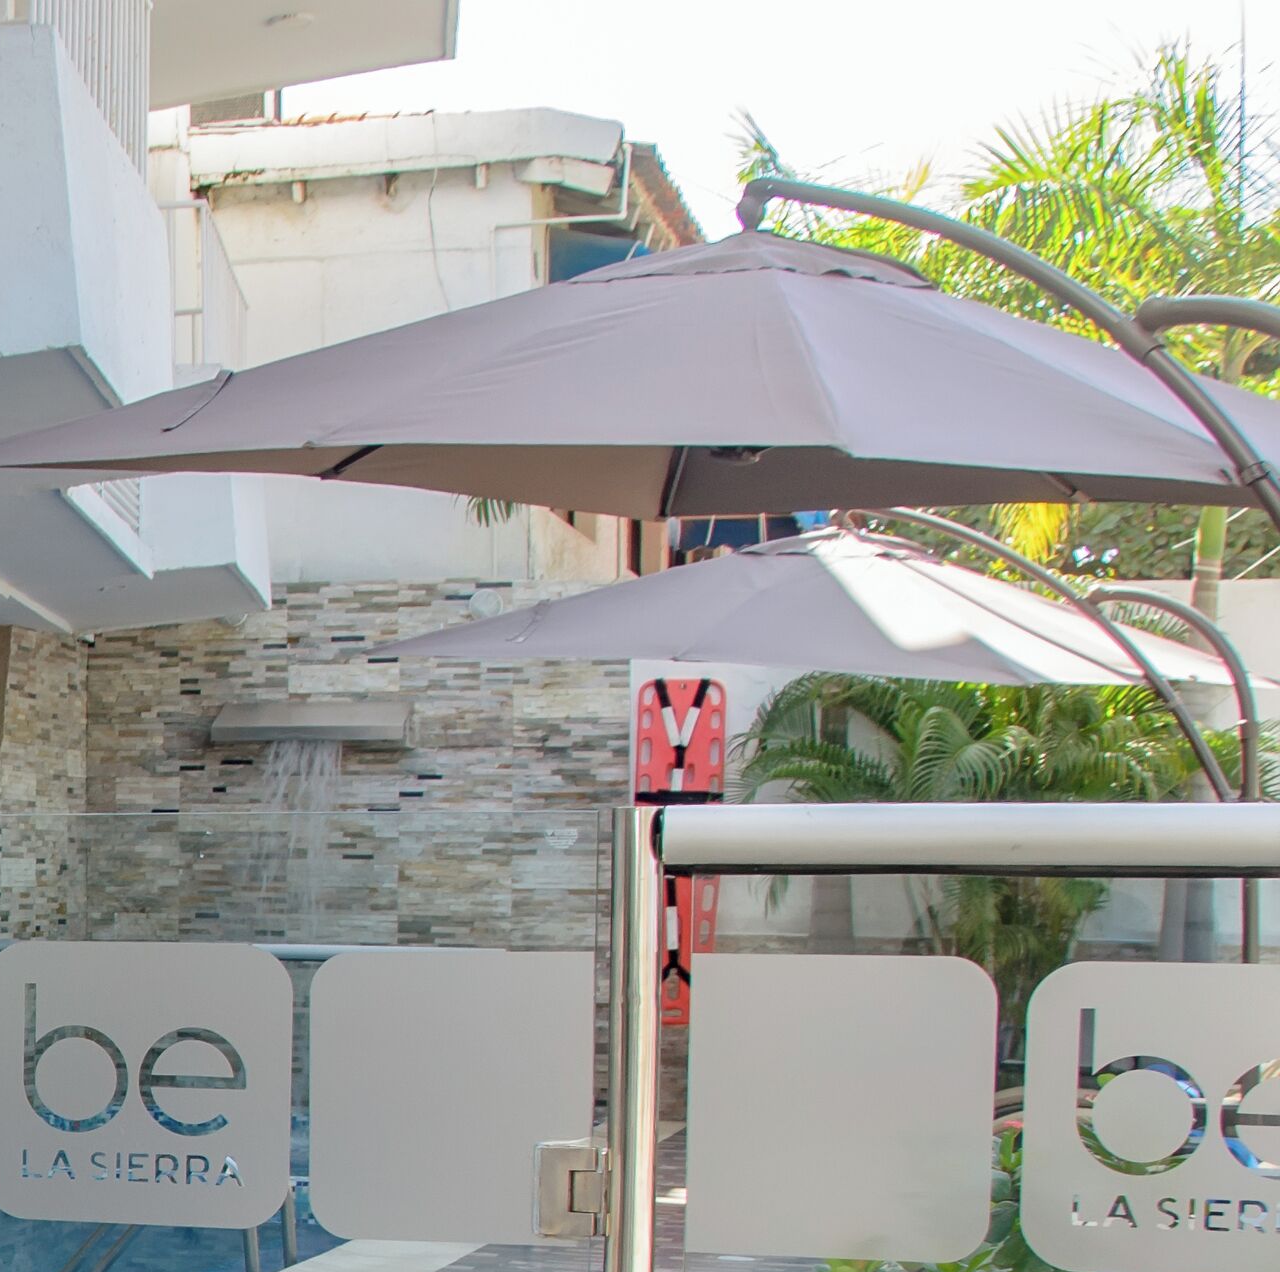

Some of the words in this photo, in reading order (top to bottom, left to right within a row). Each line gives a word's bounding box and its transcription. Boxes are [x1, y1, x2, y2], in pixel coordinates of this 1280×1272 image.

[24, 982, 247, 1137] be
[22, 1149, 74, 1181] LA
[91, 1151, 245, 1188] SIERRA
[1071, 1194, 1138, 1229] LA
[1157, 1196, 1280, 1234] SIER
